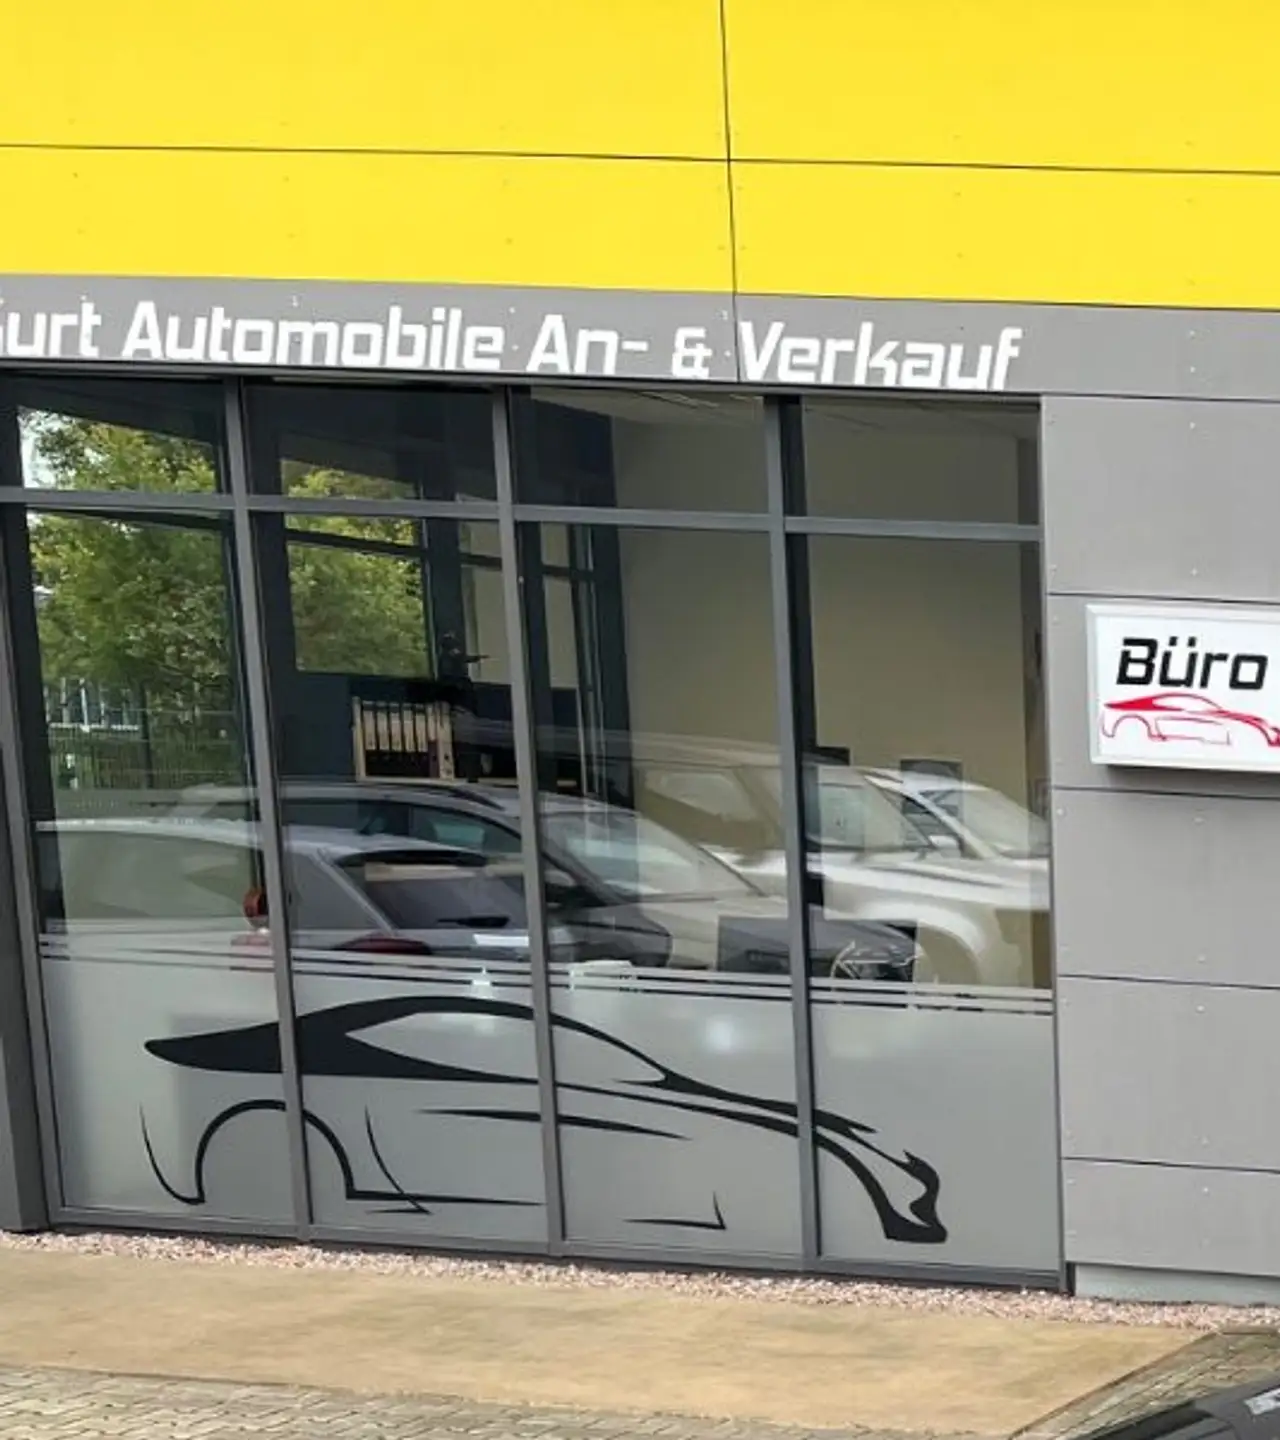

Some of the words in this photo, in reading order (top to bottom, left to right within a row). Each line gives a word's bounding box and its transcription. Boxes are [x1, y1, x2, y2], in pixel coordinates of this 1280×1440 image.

[0, 302, 102, 357] urt
[121, 301, 505, 368] Automobile
[526, 313, 649, 374] An-
[671, 327, 713, 379] &
[739, 321, 1023, 391] Verkauf
[1116, 636, 1268, 690] Büro
